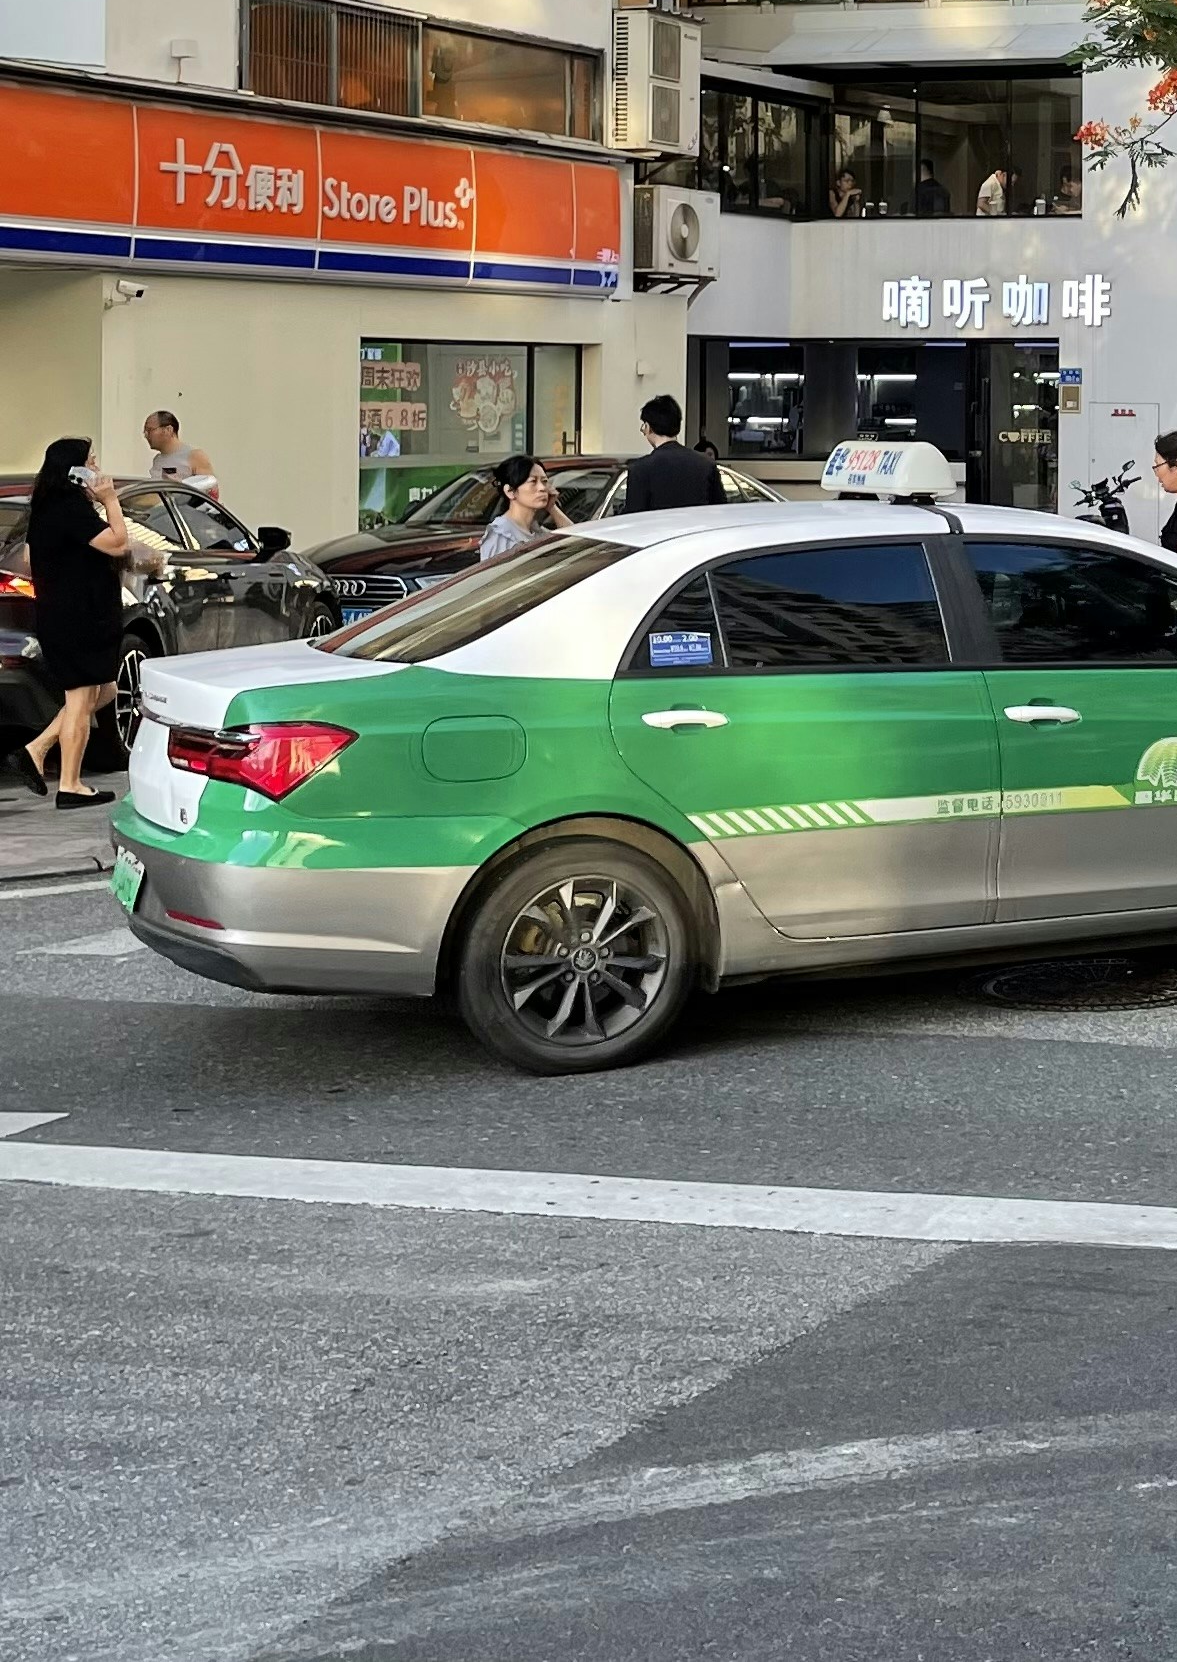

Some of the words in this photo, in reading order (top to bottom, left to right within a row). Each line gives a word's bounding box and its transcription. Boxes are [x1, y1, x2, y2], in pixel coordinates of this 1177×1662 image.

[157, 137, 305, 215] 十分便利
[322, 176, 398, 224] Store
[882, 274, 1112, 330] 嘀听咖啡
[360, 365, 420, 390] 周末狂欢
[845, 449, 882, 471] 95128
[877, 450, 903, 475] TAXI
